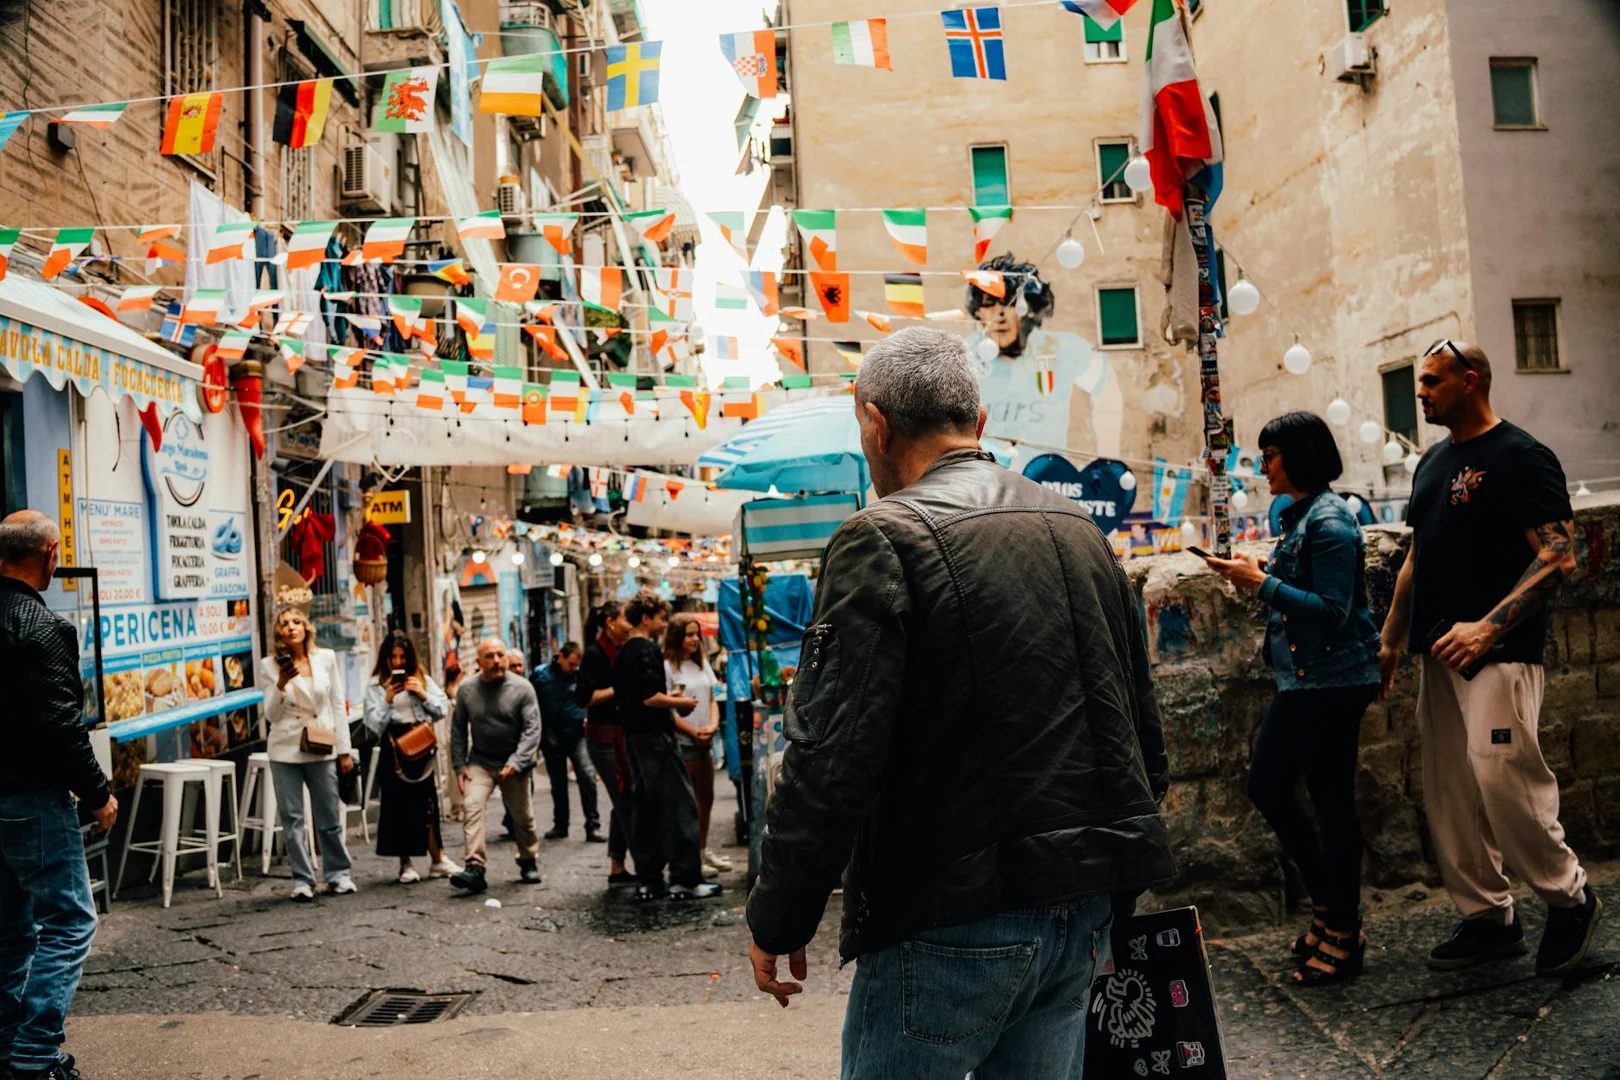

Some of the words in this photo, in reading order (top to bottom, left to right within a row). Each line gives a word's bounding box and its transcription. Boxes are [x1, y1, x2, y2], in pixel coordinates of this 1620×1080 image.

[57, 344, 99, 381] CALDA
[114, 362, 183, 404] FOCACCERIA
[986, 400, 1045, 423] ars
[62, 454, 71, 504] ATM
[114, 503, 141, 518] MARE
[371, 501, 403, 513] ATM
[64, 517, 74, 585] HERE
[84, 607, 197, 651] APERICENA
